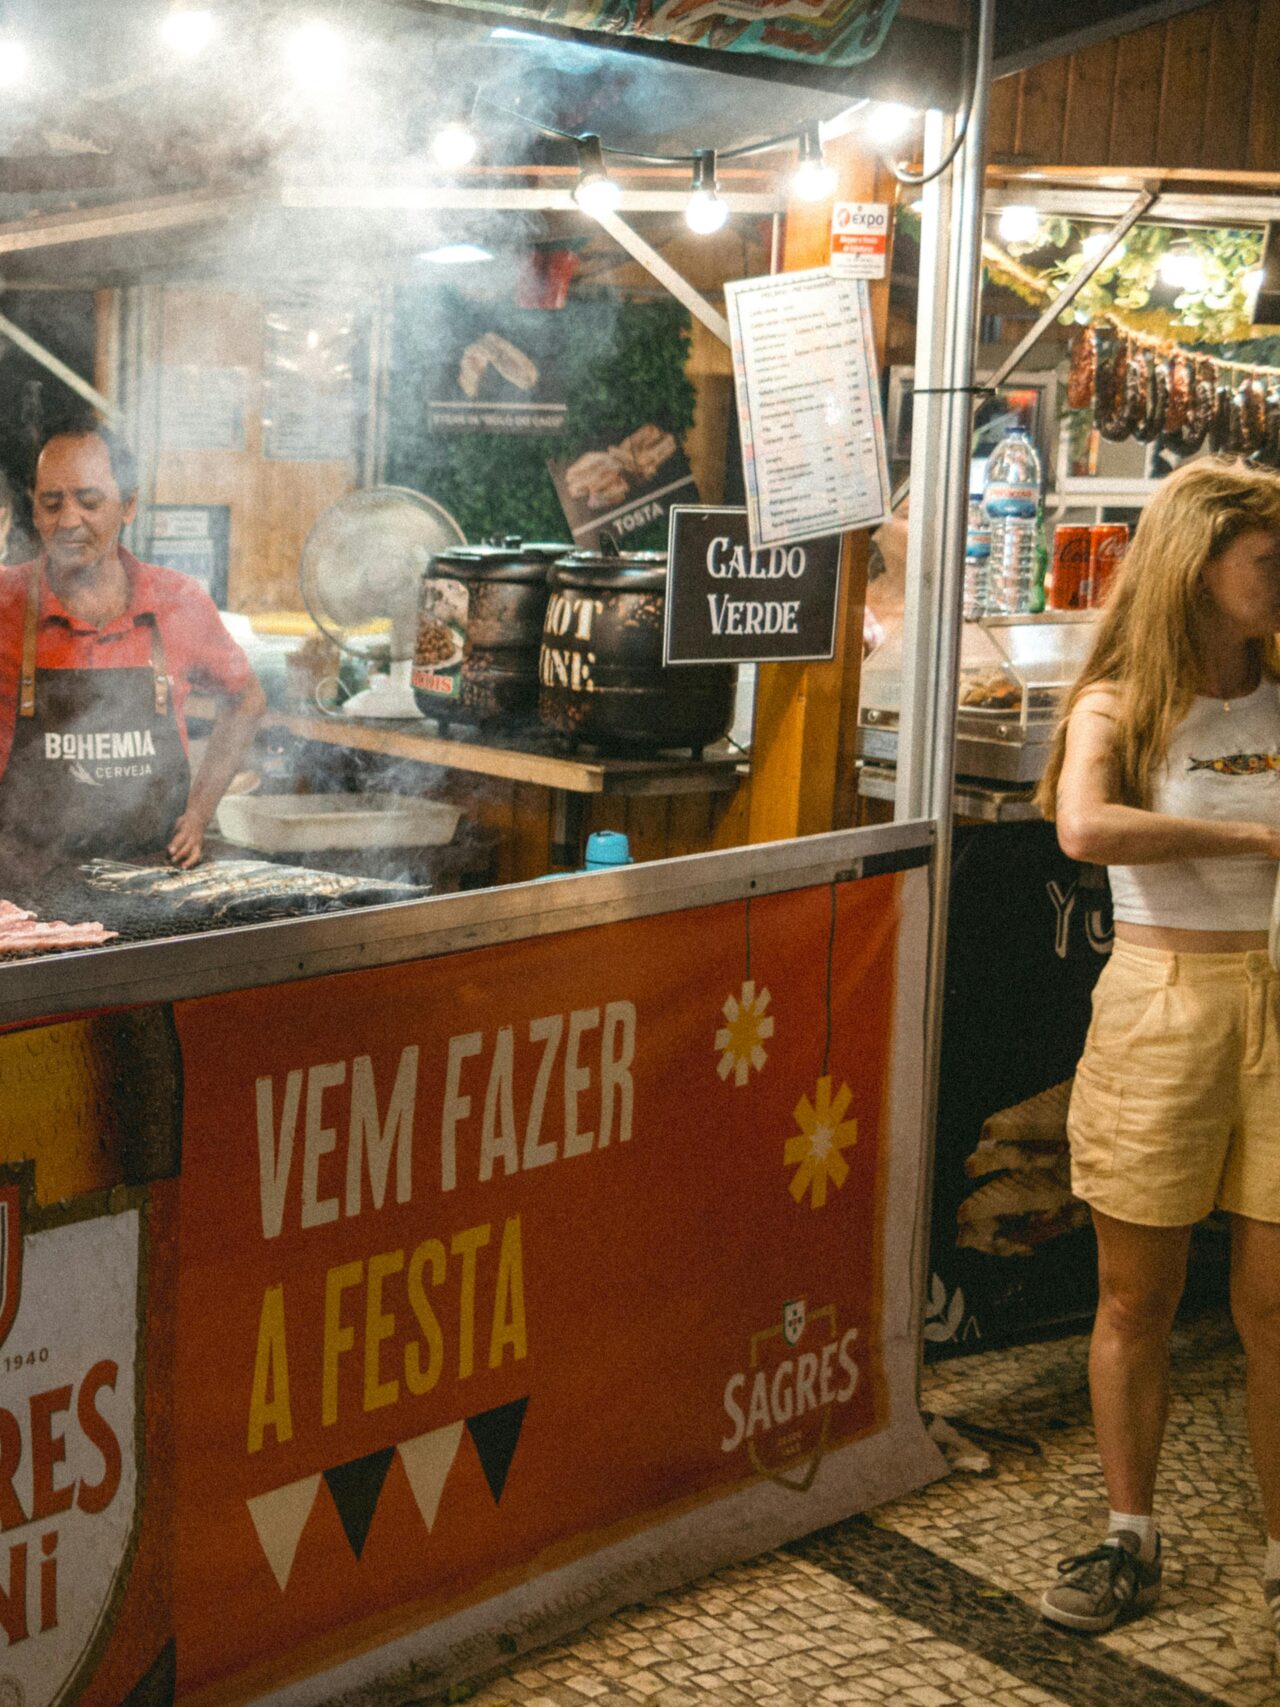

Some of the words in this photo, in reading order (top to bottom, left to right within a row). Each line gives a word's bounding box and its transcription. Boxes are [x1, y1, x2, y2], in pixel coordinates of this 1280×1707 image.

[852, 213, 885, 229] expo
[612, 502, 665, 536] TOSTA
[705, 535, 806, 580] CALDO
[706, 593, 801, 636] VERDE
[44, 729, 156, 760] BOHEMIA
[95, 763, 153, 779] CERVEJA
[256, 1044, 419, 1240] VEM
[441, 1000, 637, 1193] FAZER
[247, 1283, 293, 1454] A
[322, 1212, 528, 1427] FESTA
[3, 1347, 50, 1373] 1940
[721, 1328, 860, 1452] SAGRES
